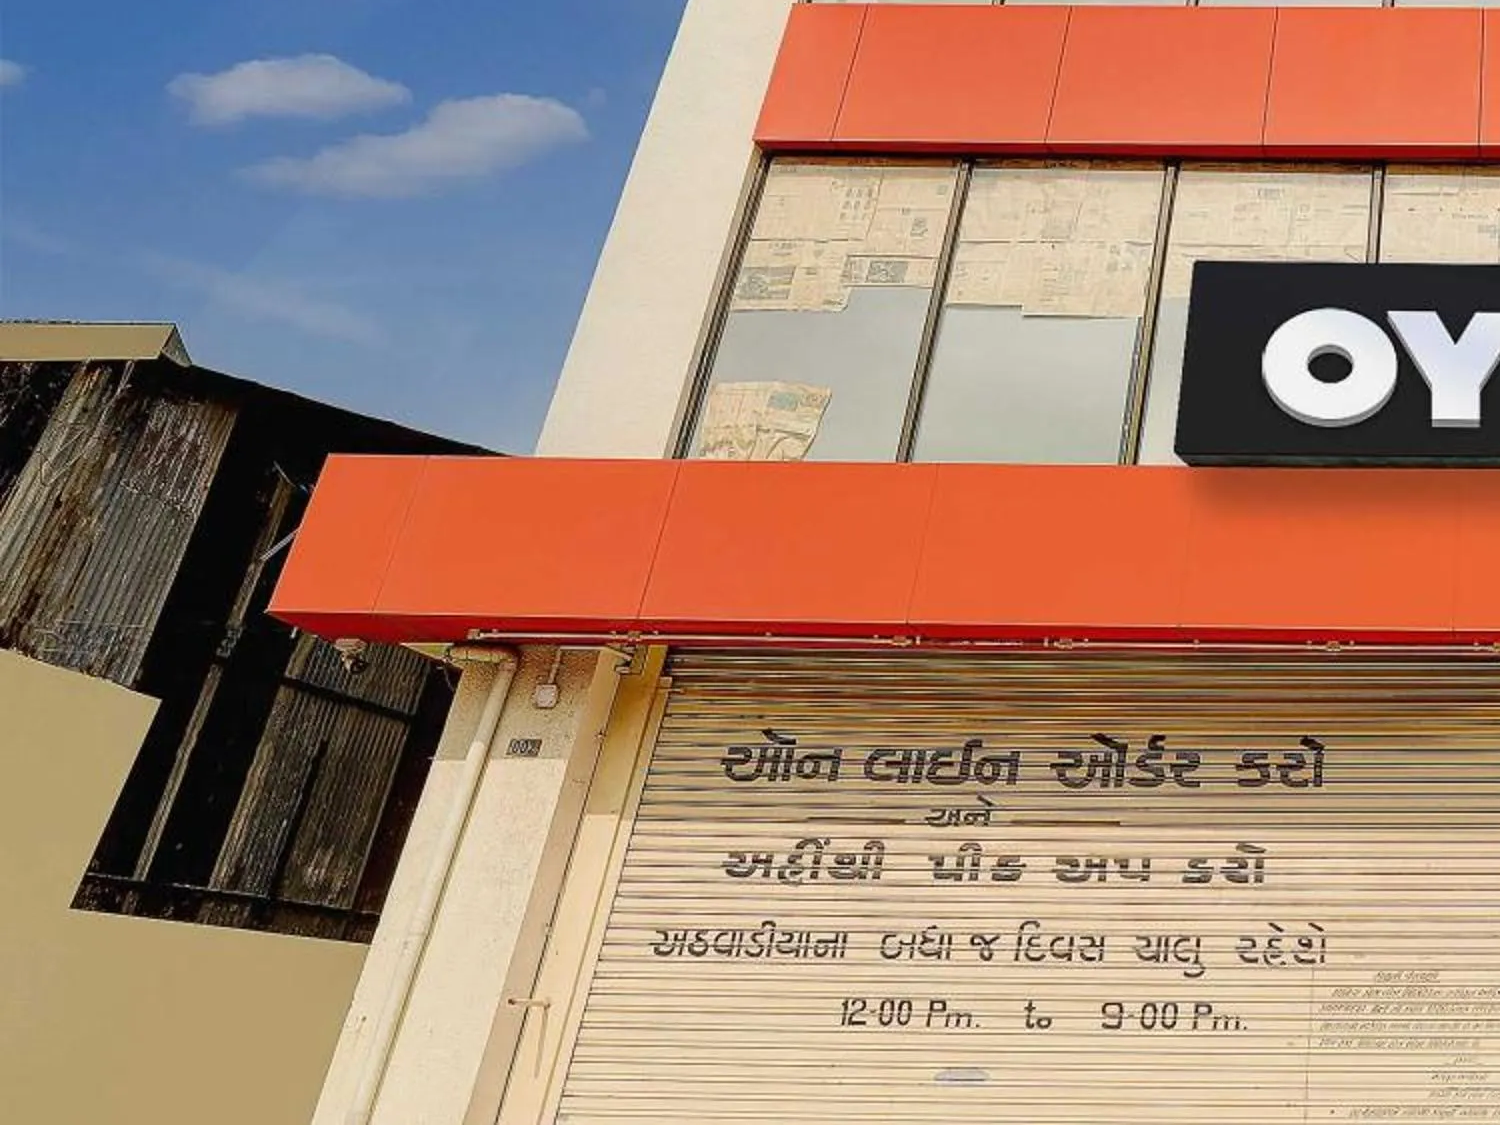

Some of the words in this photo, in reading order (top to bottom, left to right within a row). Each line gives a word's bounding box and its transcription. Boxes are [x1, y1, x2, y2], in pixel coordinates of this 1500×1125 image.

[720, 728, 844, 783] ઓન
[863, 739, 1021, 786] લાઈન
[1050, 732, 1201, 789] ઓર્ડર
[1236, 735, 1326, 788] કરો
[925, 795, 995, 827] અને
[720, 838, 886, 885] અહીંથી
[928, 842, 1027, 882] પીક
[1052, 857, 1151, 883] અપ
[1181, 842, 1268, 884] કરો
[648, 920, 848, 959] અઠવાડીયાના
[969, 933, 1002, 962] જ
[1013, 920, 1105, 962] દિવસ
[1131, 935, 1206, 978] ચાલુ
[1234, 922, 1327, 966] રહેશે
[1023, 1000, 1053, 1030] to
